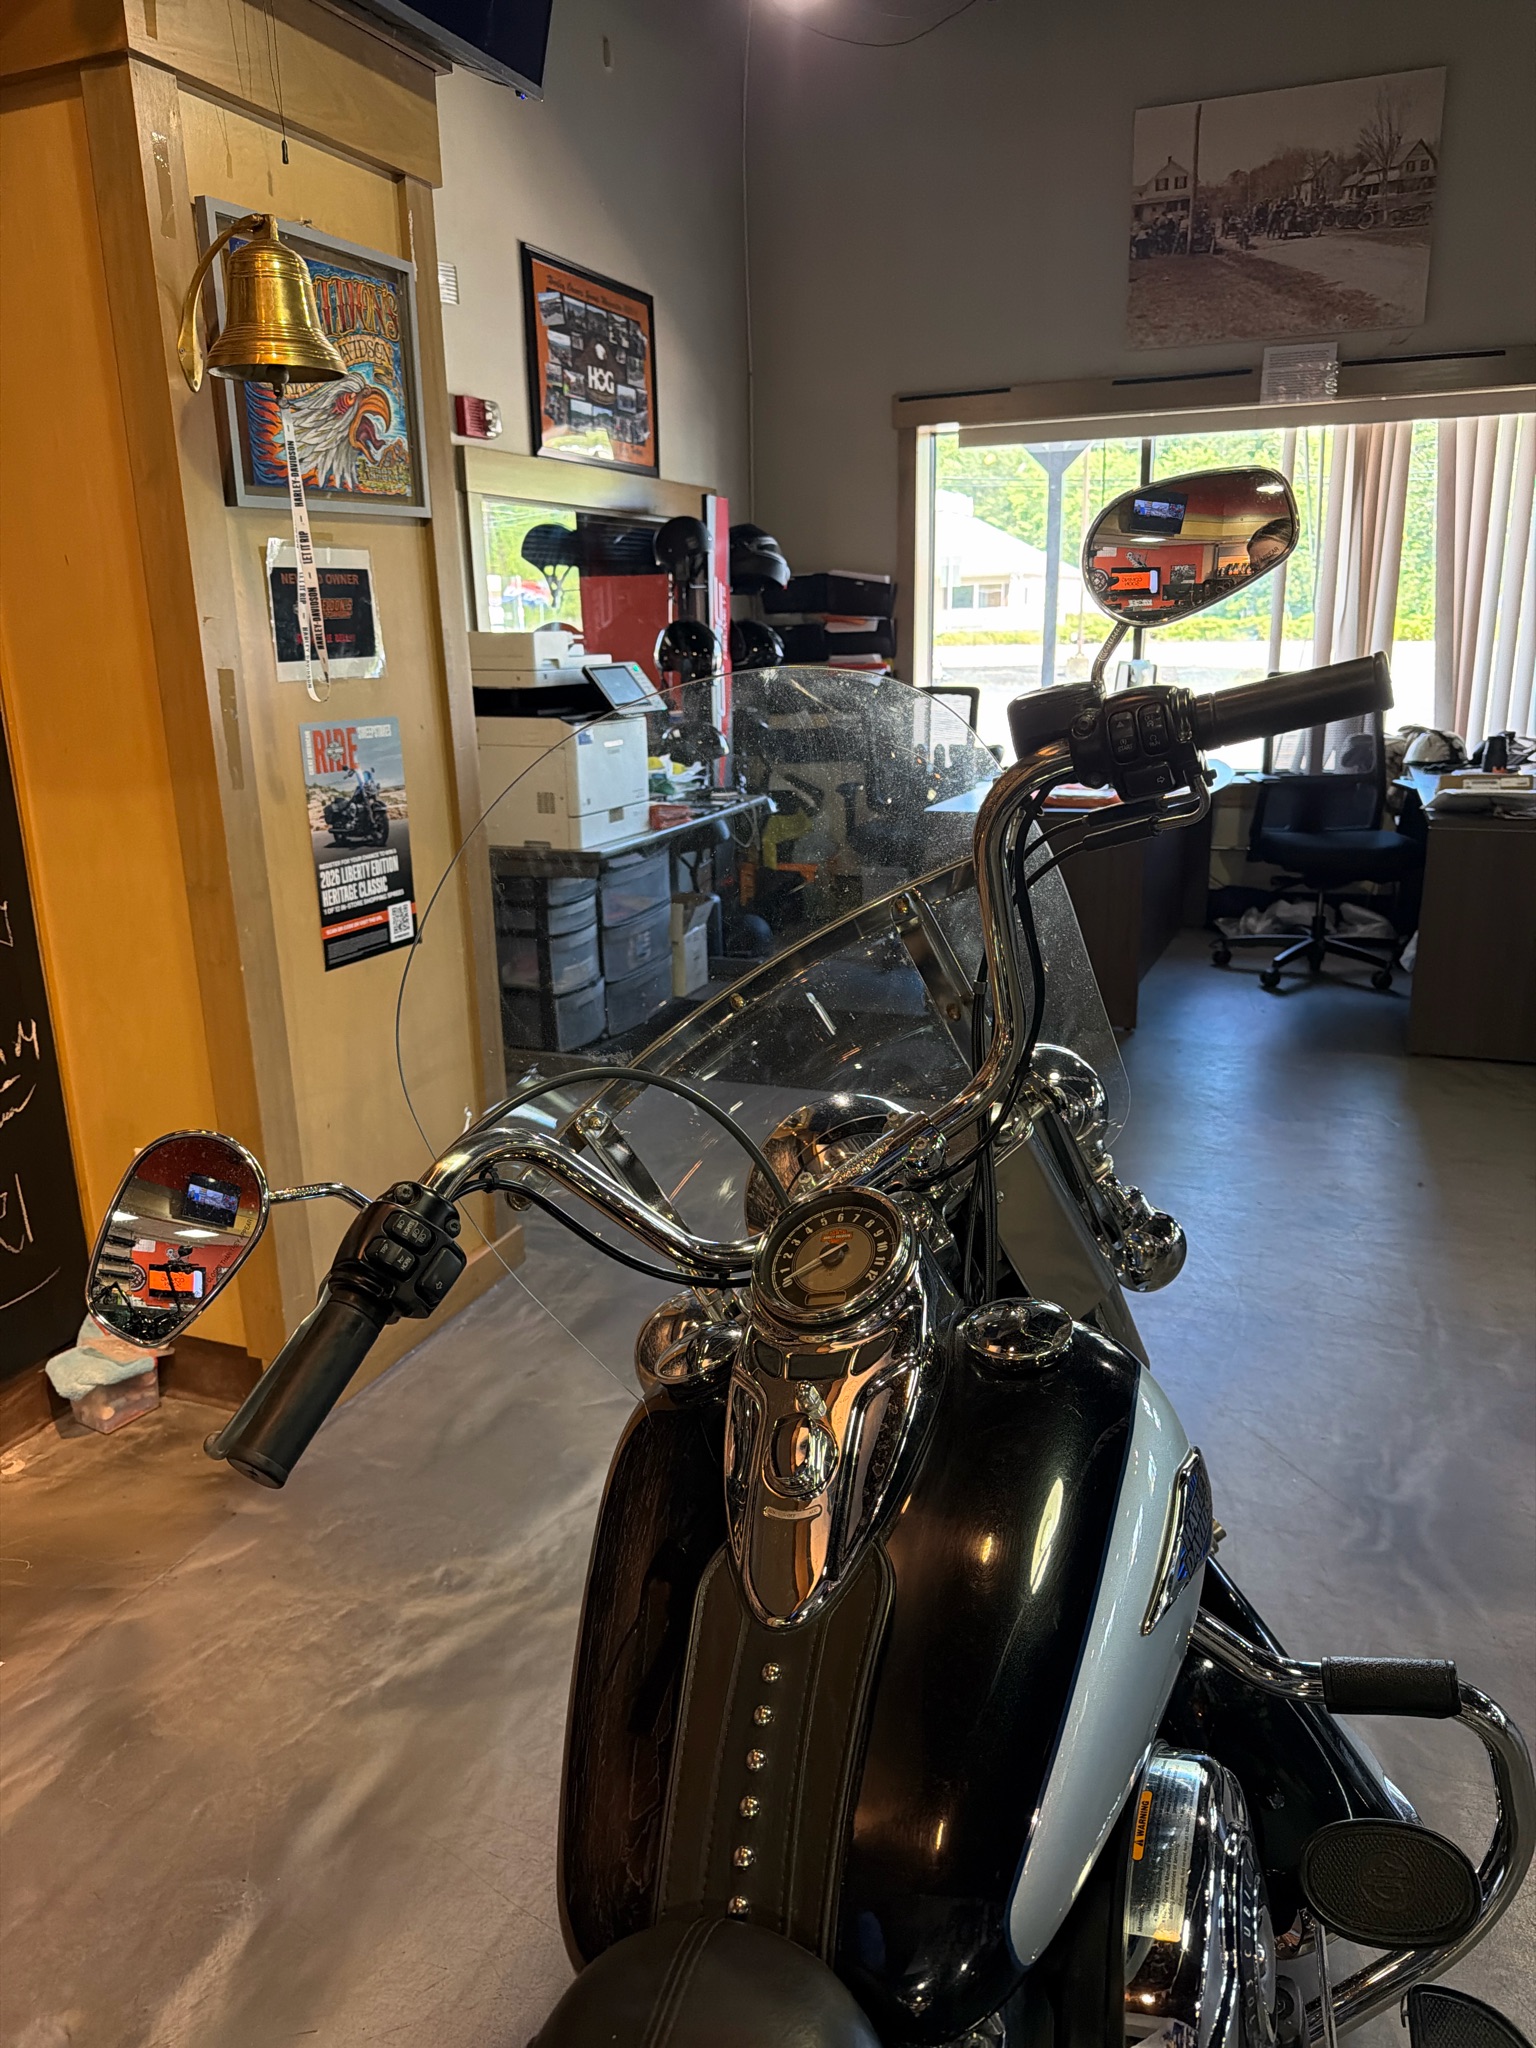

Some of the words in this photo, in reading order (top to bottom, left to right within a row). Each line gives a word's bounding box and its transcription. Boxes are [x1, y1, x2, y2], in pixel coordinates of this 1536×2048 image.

[339, 337, 393, 369] AVIDSON
[588, 365, 615, 395] HOG
[287, 440, 304, 507] HARLEY-DAVIDSON
[281, 573, 299, 585] NE
[325, 574, 359, 585] OWNER
[307, 587, 325, 650] HARLEY-DAVIDSON
[312, 727, 359, 774] RIDE
[320, 868, 340, 889] 2026
[340, 861, 371, 884] LIBERTY
[370, 855, 399, 878] EDITION
[322, 883, 358, 908] HERITAGE
[359, 876, 389, 898] CLASSIC
[820, 1217, 828, 1226] 5
[837, 1213, 844, 1222] 6
[852, 1214, 860, 1222] 7
[864, 1219, 875, 1228] 8
[804, 1226, 814, 1234] 4
[874, 1228, 884, 1238] 9
[790, 1238, 802, 1246] 3
[876, 1240, 888, 1252] 10
[782, 1252, 794, 1260] 2
[875, 1256, 886, 1266] 11
[400, 1256, 412, 1272] HORN
[864, 1269, 879, 1282] 12
[781, 1278, 793, 1288] 0
[1137, 1800, 1150, 1836] WARNING
